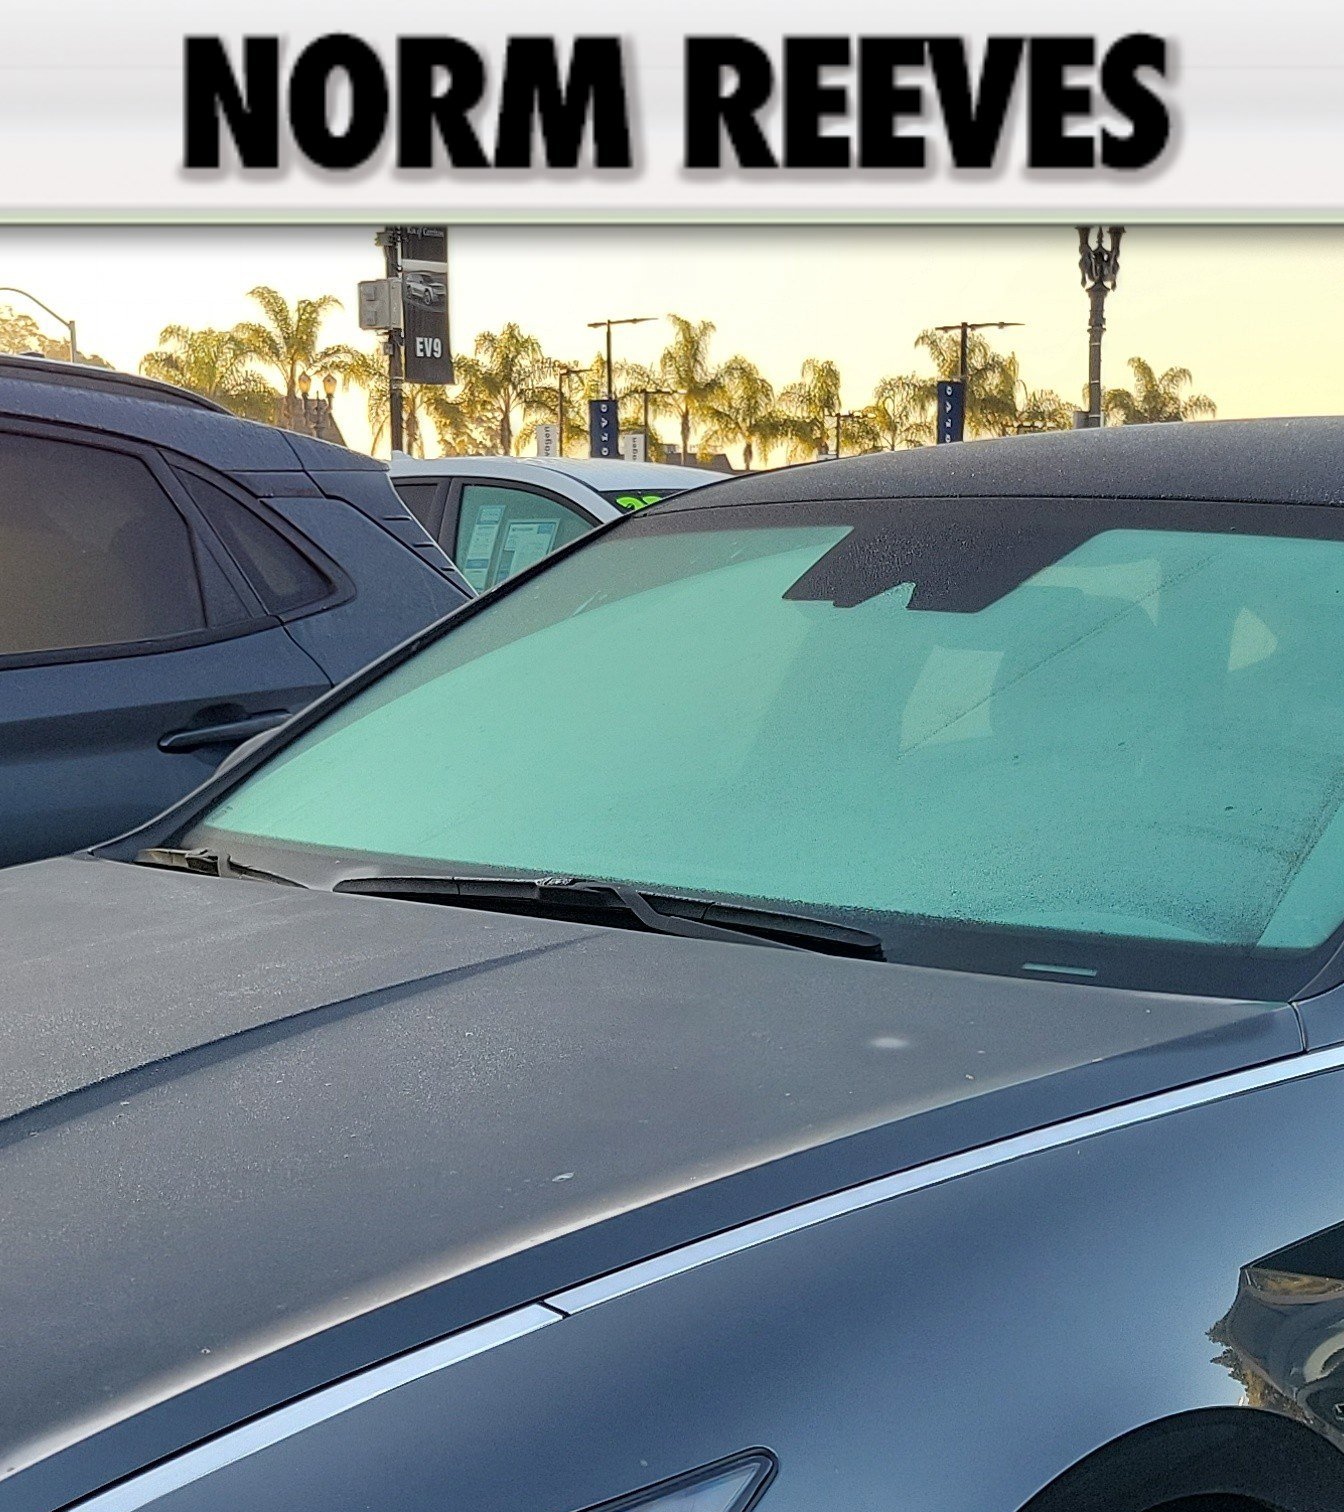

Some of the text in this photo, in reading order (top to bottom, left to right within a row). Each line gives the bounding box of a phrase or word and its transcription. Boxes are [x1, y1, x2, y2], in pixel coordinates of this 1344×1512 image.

[416, 337, 442, 358] EV9
[601, 404, 609, 456] OLVO
[944, 385, 953, 443] OLVO
